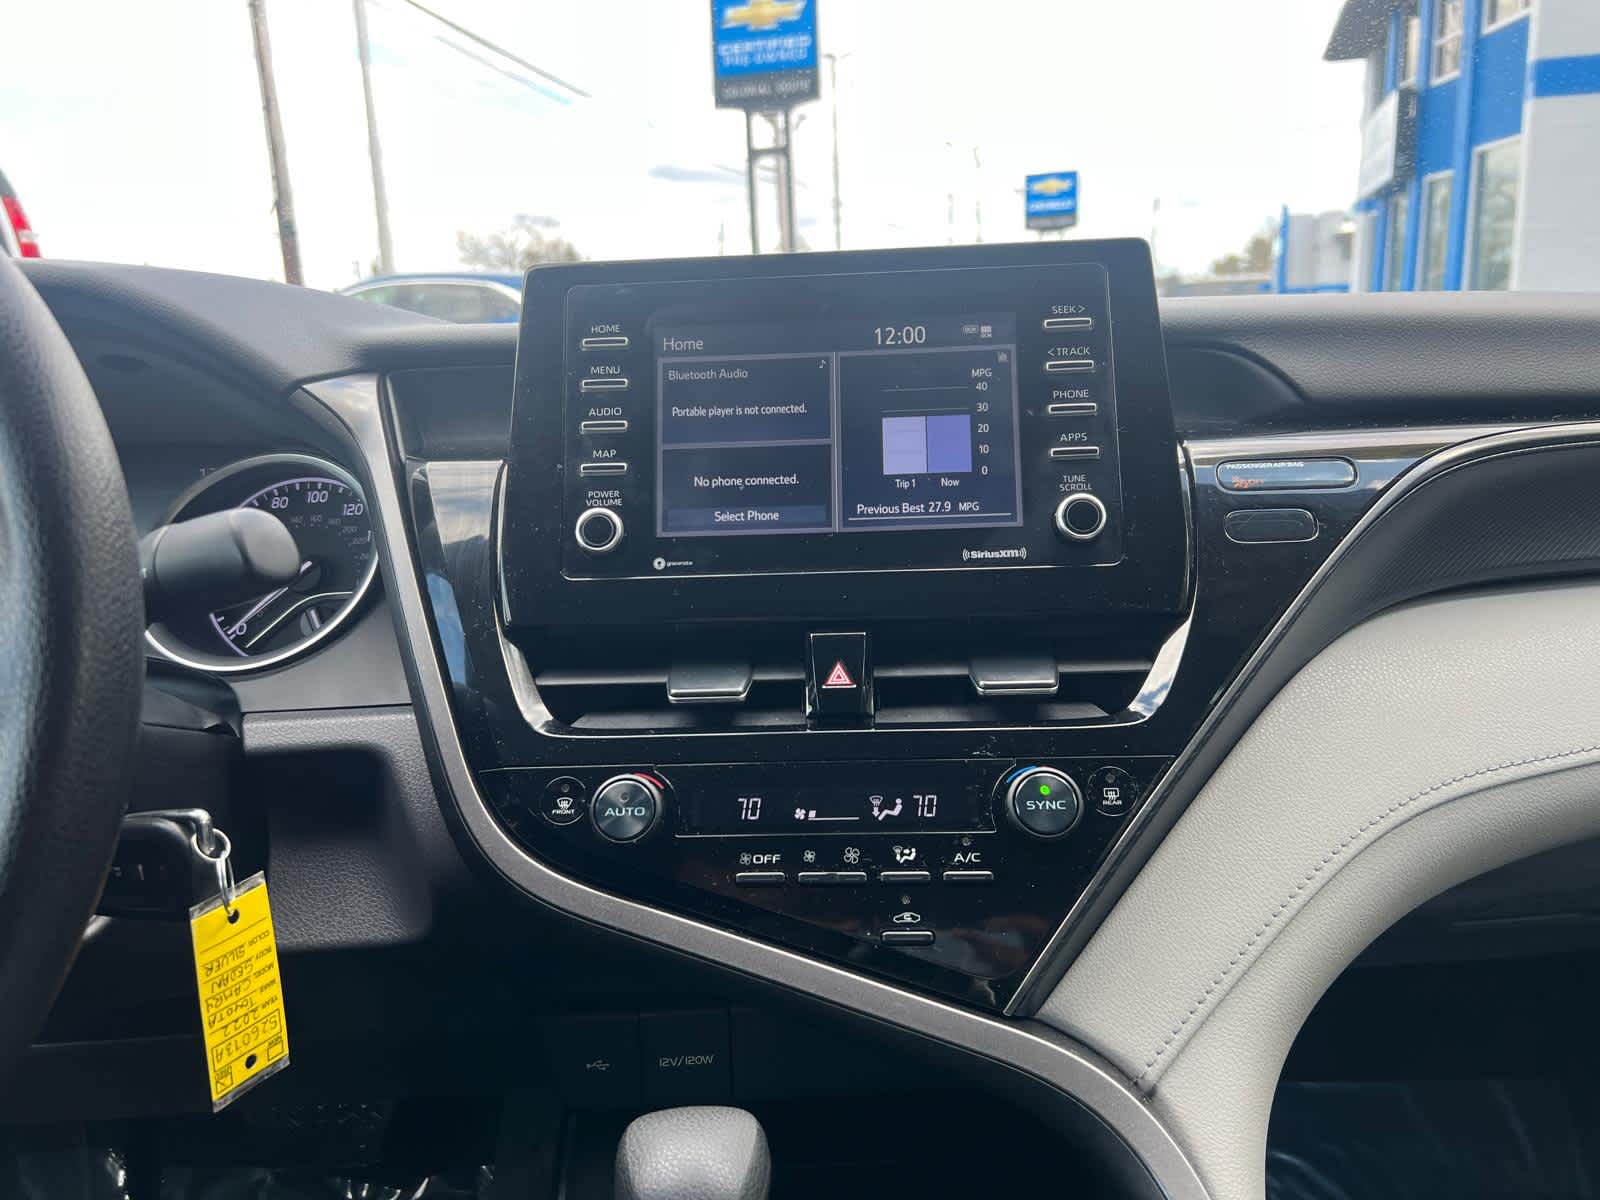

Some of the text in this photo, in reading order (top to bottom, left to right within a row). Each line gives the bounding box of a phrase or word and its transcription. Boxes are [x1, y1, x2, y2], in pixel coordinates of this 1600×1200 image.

[1051, 305, 1077, 314] SEEK
[591, 324, 620, 334] HOME
[874, 326, 927, 345] 12:00
[663, 337, 704, 351] Home
[1055, 346, 1090, 356] TRACK
[590, 366, 621, 375] MENU
[668, 368, 749, 381] Bluetooth Audio
[971, 368, 993, 379] MPG
[975, 382, 988, 392] 40
[1053, 389, 1089, 399] PHONE
[588, 407, 622, 417] AUDIO
[672, 403, 807, 417] Portable player is not connected.
[976, 402, 989, 412] 30
[977, 423, 989, 433] 20
[1060, 432, 1088, 442] APPS
[592, 449, 617, 459] MAP
[979, 444, 989, 454] 10
[981, 465, 988, 475] 0
[694, 474, 800, 489] No phone connected.
[895, 478, 916, 490] Trip 1
[940, 476, 960, 488] Now
[1062, 474, 1086, 483] TUNE
[1059, 481, 1093, 492] SCROLL
[307, 491, 328, 503] 100
[588, 490, 620, 498] POWER
[271, 497, 288, 509] 80
[585, 498, 623, 507] VOLUME
[856, 501, 980, 515] Previous Best 27.9 MPG
[343, 503, 363, 516] 120
[714, 510, 779, 522] Select Phone
[236, 623, 247, 635] 0
[738, 798, 760, 820] 70
[913, 795, 937, 817] 70
[1026, 800, 1067, 810] SYNC
[604, 806, 646, 817] AUTO
[753, 854, 781, 864] OFF
[954, 852, 981, 862] A/C
[204, 944, 246, 977] SILVER
[211, 960, 254, 993] SEDAN
[206, 976, 251, 1013] CAMRY
[223, 1008, 260, 1037] 2022
[659, 1055, 714, 1068] 12V/120W
